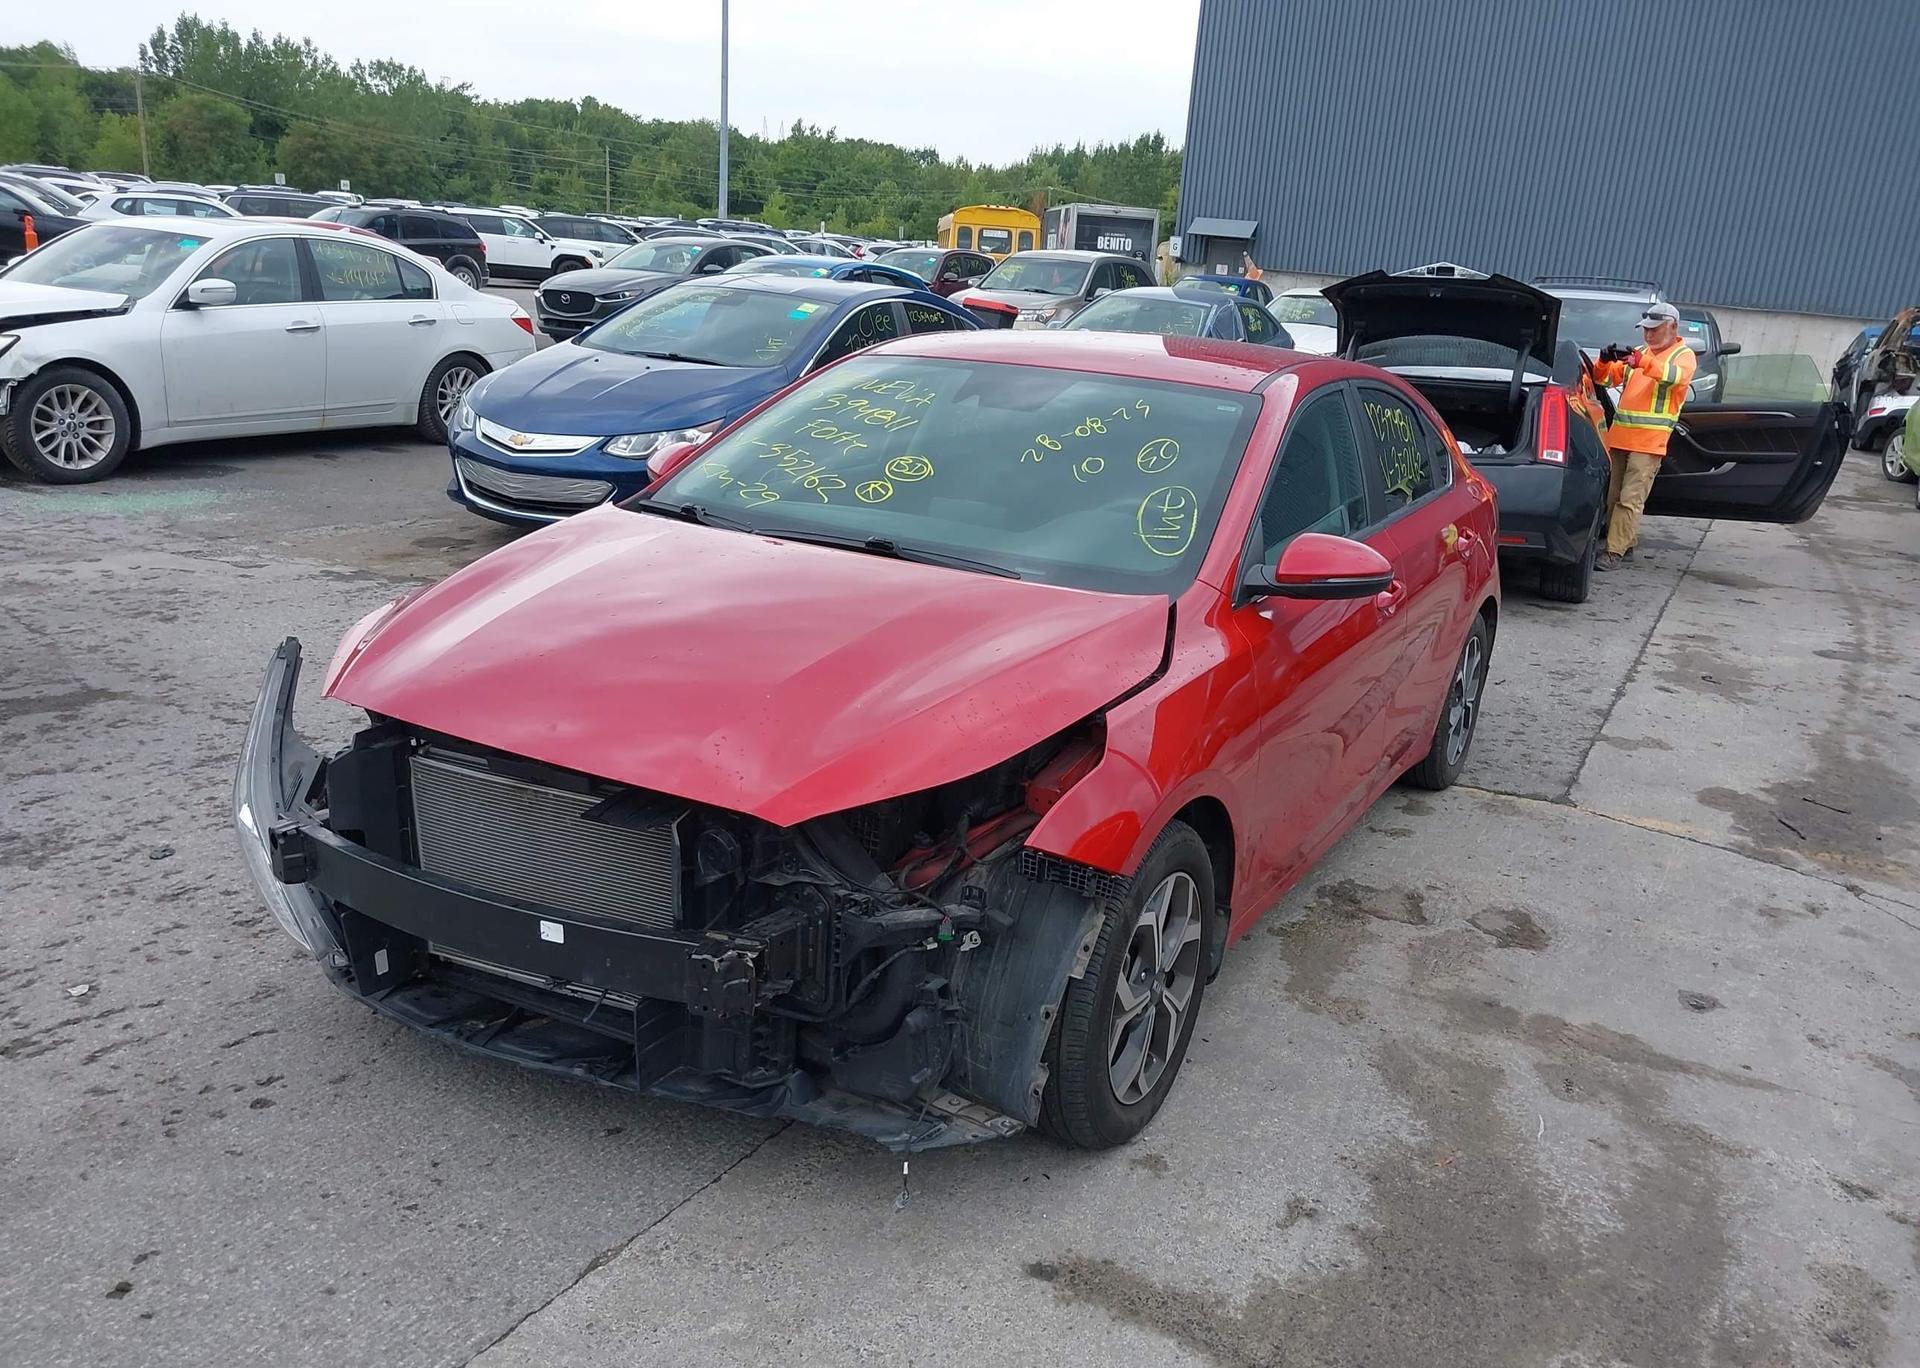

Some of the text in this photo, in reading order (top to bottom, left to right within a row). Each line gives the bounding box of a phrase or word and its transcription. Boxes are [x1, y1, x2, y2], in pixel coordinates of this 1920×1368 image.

[1097, 236, 1133, 252] BENITO
[1172, 243, 1179, 251] G
[859, 307, 893, 338] Clée
